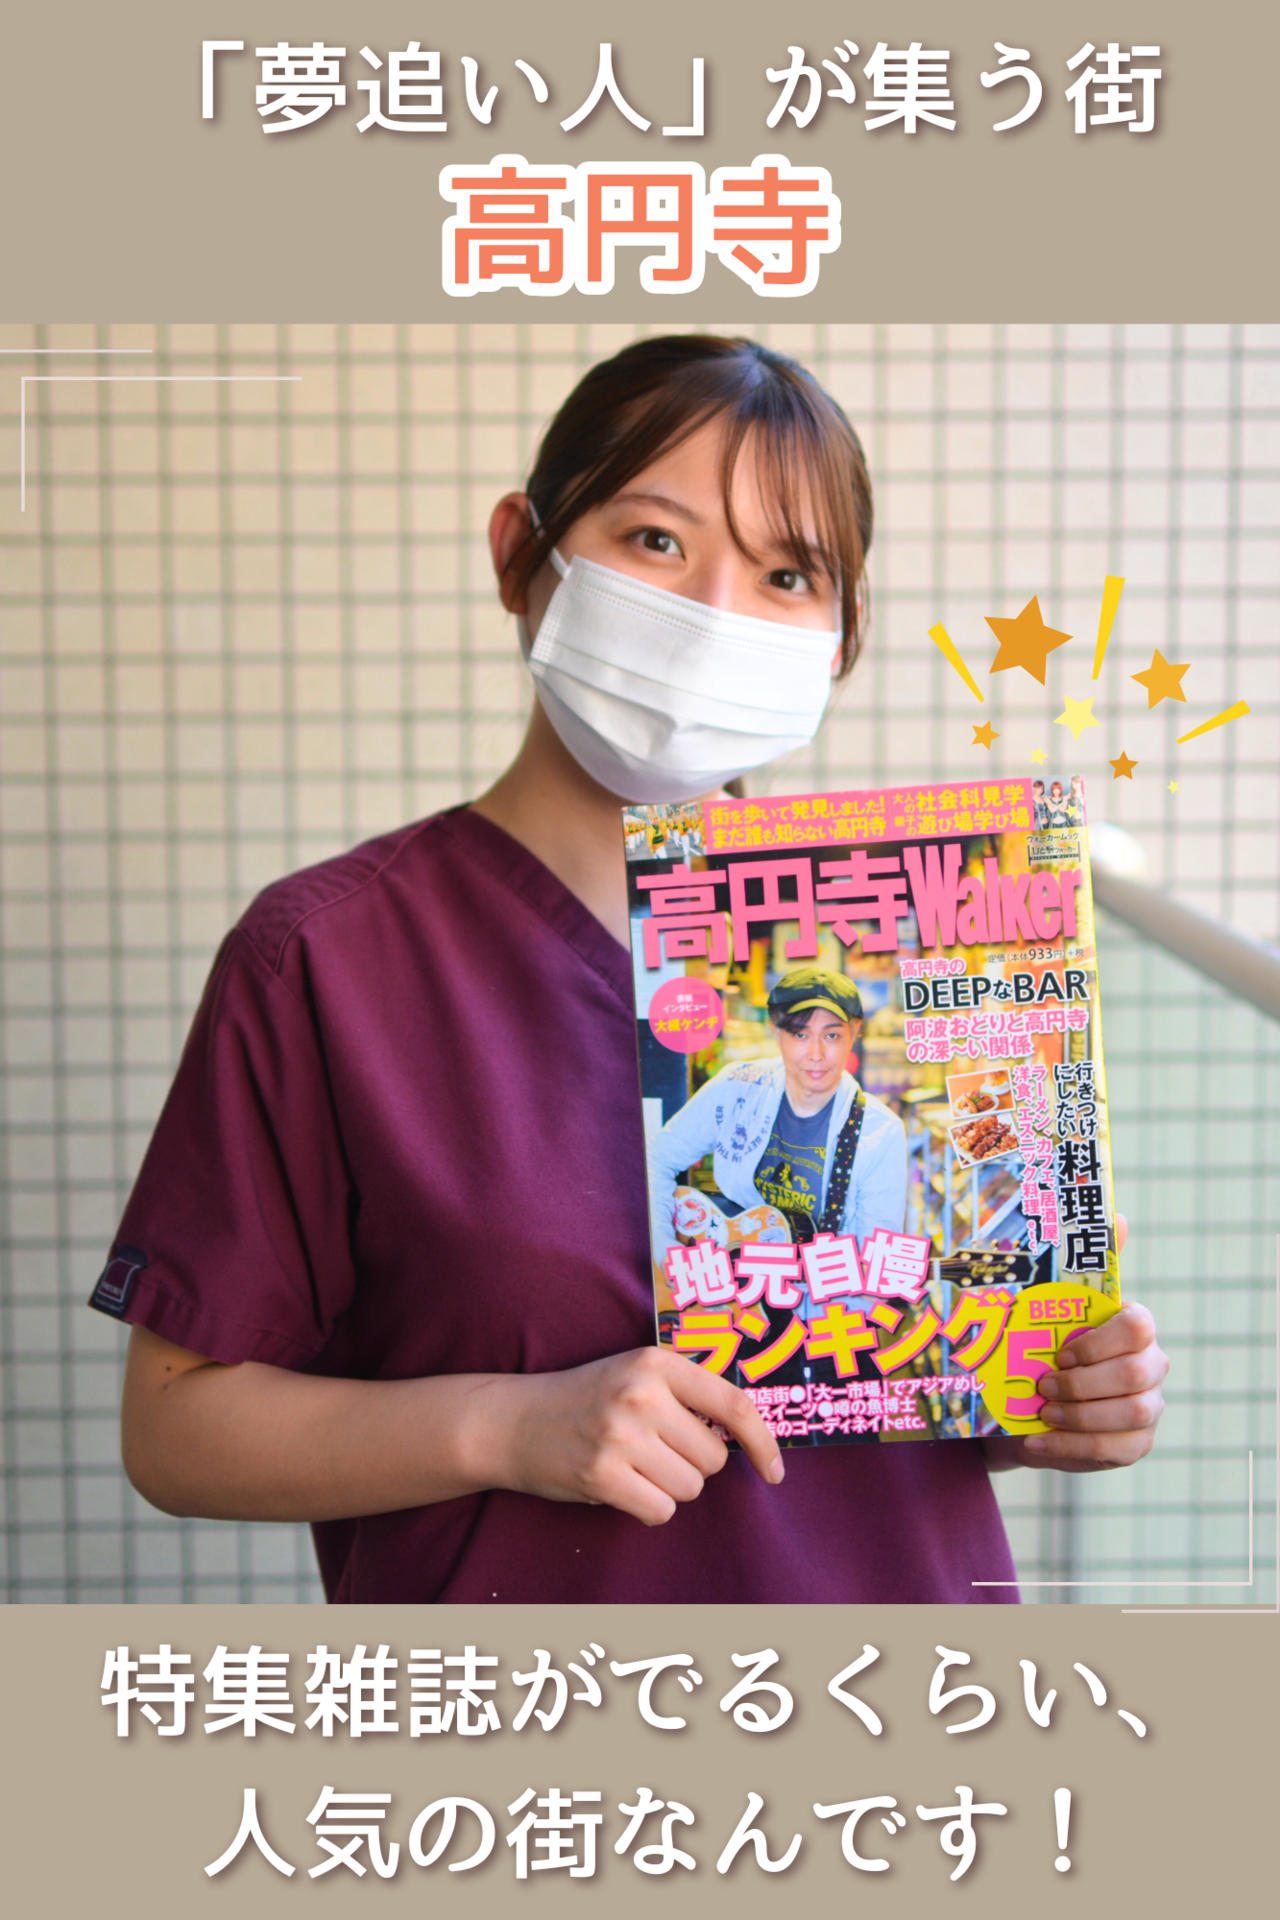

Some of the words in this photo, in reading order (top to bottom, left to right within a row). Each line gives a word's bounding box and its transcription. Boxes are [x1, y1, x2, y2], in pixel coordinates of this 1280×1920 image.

[711, 816, 888, 849] まだ誰も知らない高円寺
[901, 958, 966, 978] 高円寺の
[662, 1003, 708, 1014] インタビュー
[904, 969, 1089, 1012] DEEPなBAR
[905, 1008, 1088, 1041] 阿波おどりと高円寺
[1074, 1062, 1098, 1137] 行きつけ
[1058, 1139, 1108, 1272] 料理店
[668, 1229, 931, 1309] 地元自慢
[1029, 1297, 1086, 1320] BEST
[673, 1287, 1016, 1383] ランキング
